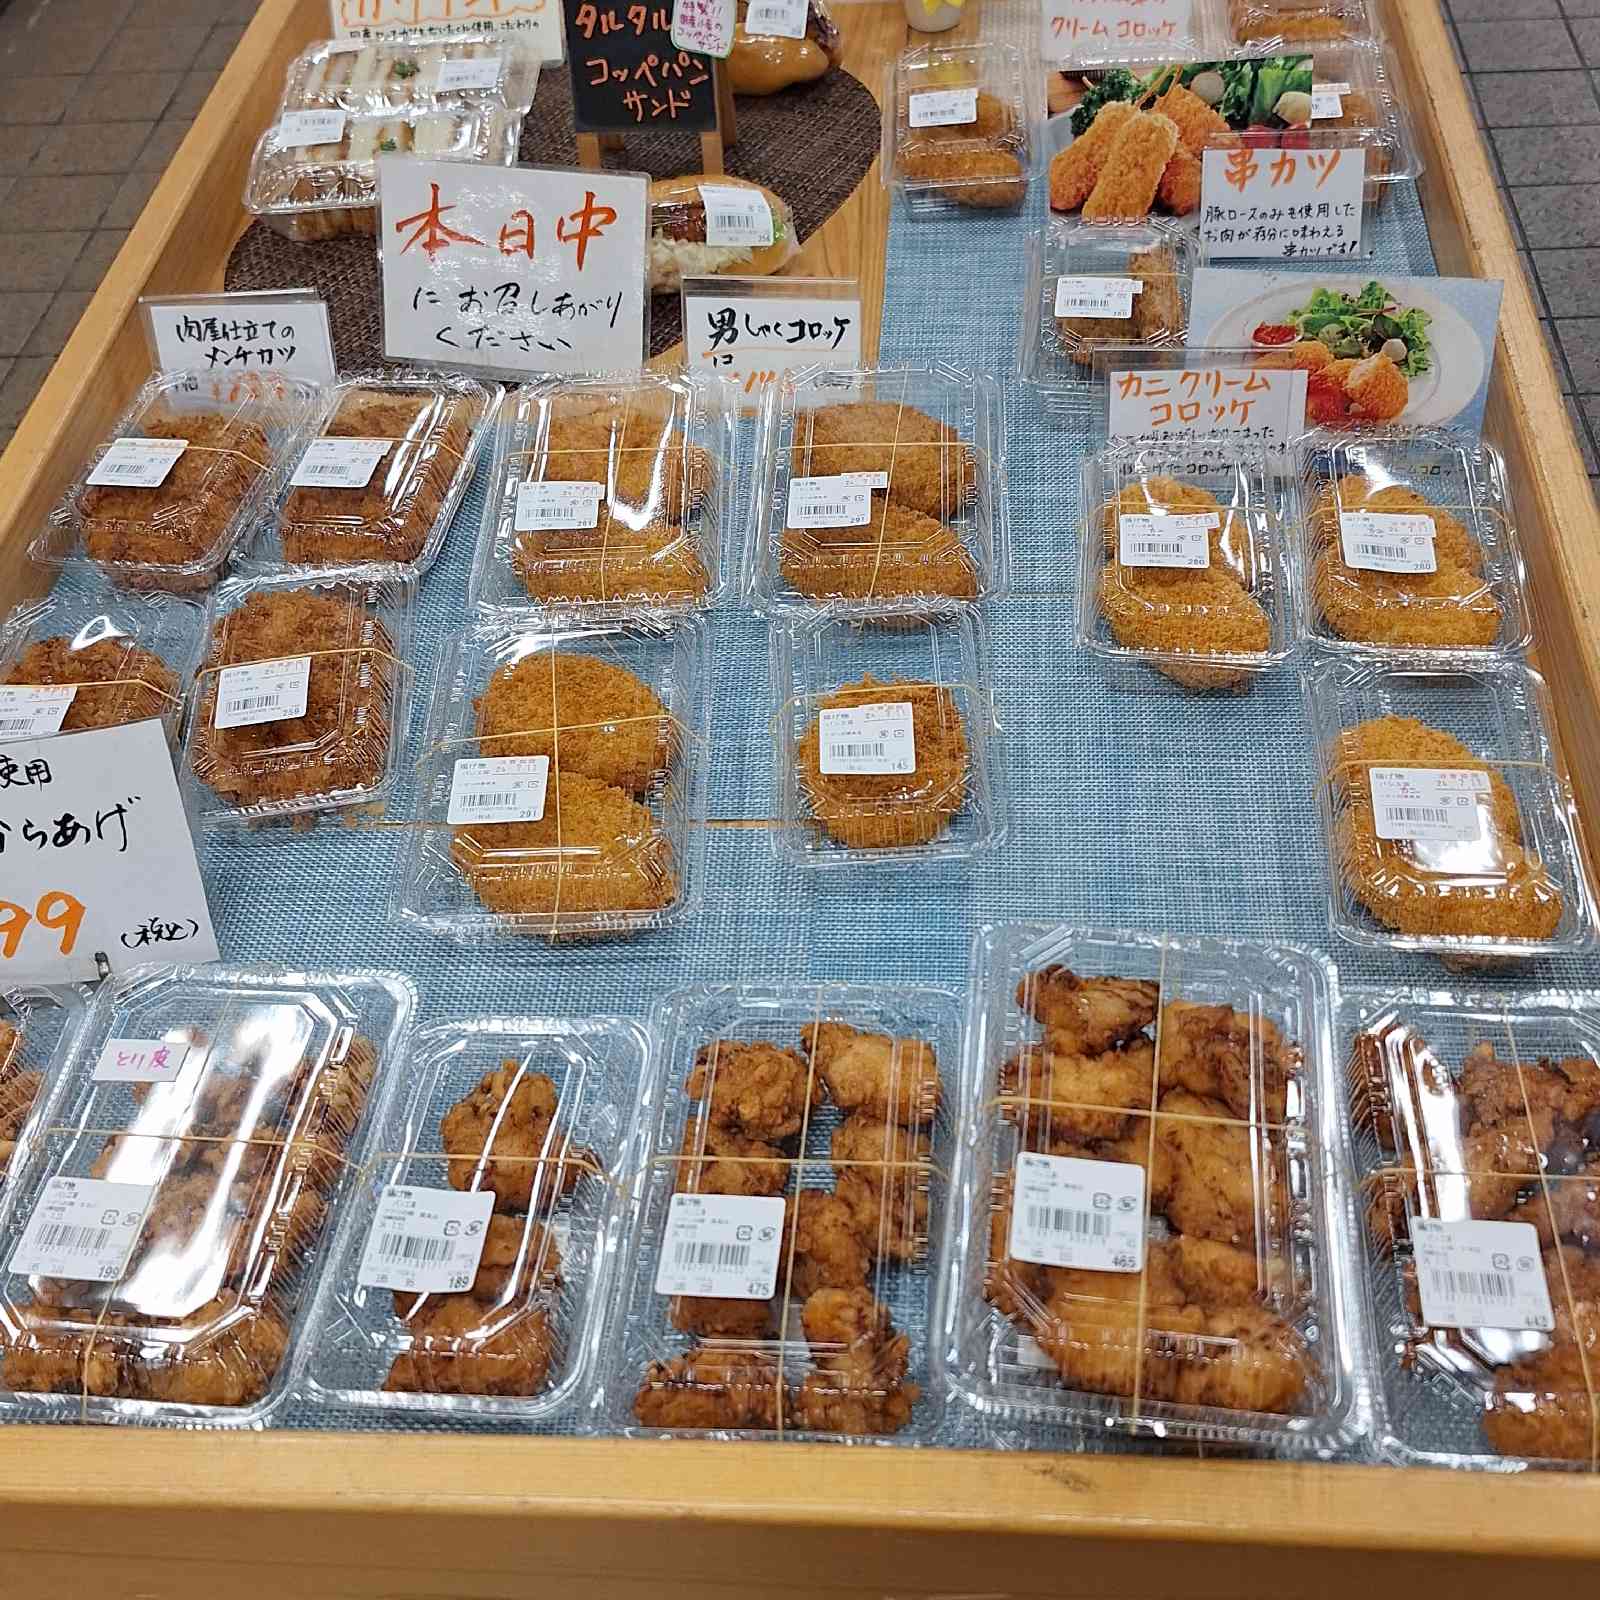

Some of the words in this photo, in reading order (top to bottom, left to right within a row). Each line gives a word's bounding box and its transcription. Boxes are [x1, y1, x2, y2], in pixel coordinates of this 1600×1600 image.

[575, 3, 672, 38] タルタル
[586, 52, 709, 87] コッペパン
[624, 88, 692, 122] サンド
[1224, 148, 1342, 192] 串カツ
[396, 183, 618, 271] 本日中
[176, 314, 295, 343] 肉屋仕立ての
[707, 307, 851, 351] 男しゃくコロッケ
[204, 345, 297, 368] メンチカツ
[1150, 399, 1255, 426] コロッケ
[98, 1265, 121, 1279] 199
